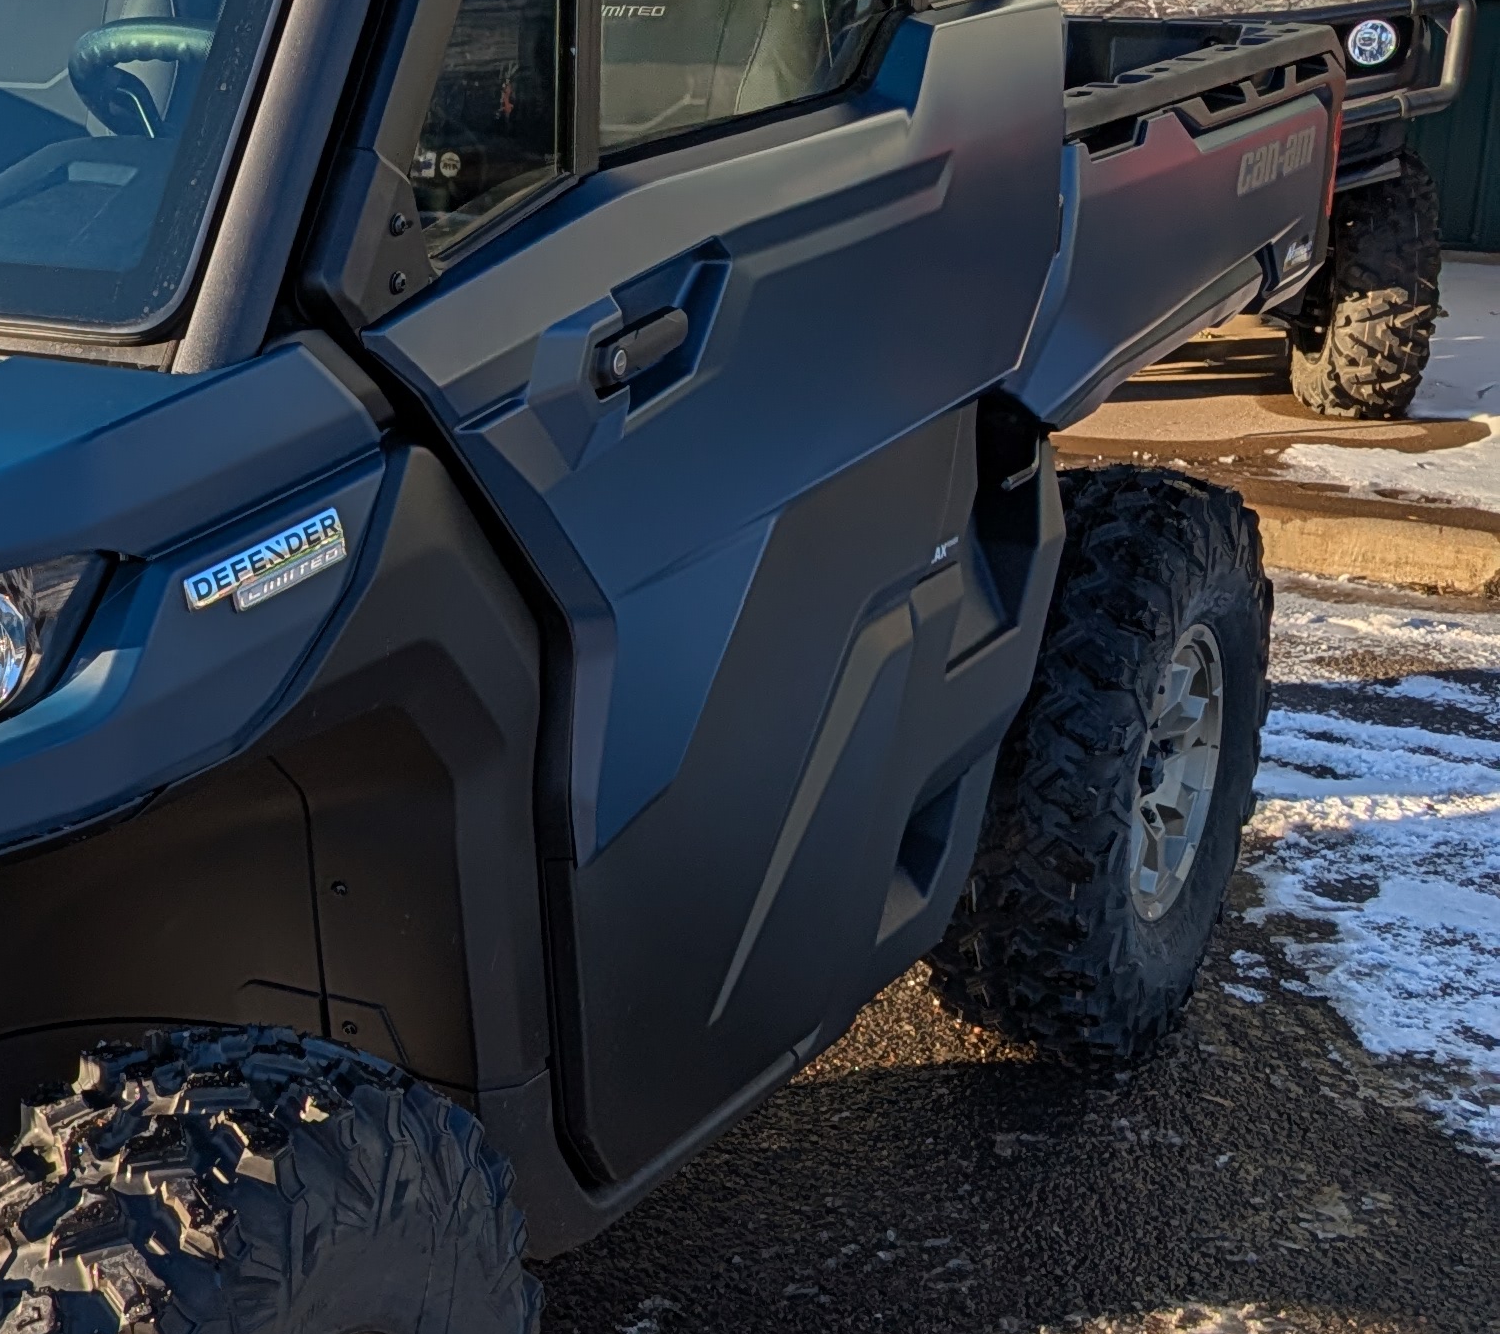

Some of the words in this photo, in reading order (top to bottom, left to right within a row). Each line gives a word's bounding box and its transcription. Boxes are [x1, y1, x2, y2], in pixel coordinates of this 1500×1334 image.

[601, 4, 666, 17] IMITED
[191, 513, 342, 602] DEFENDER
[246, 547, 340, 602] LIMITED
